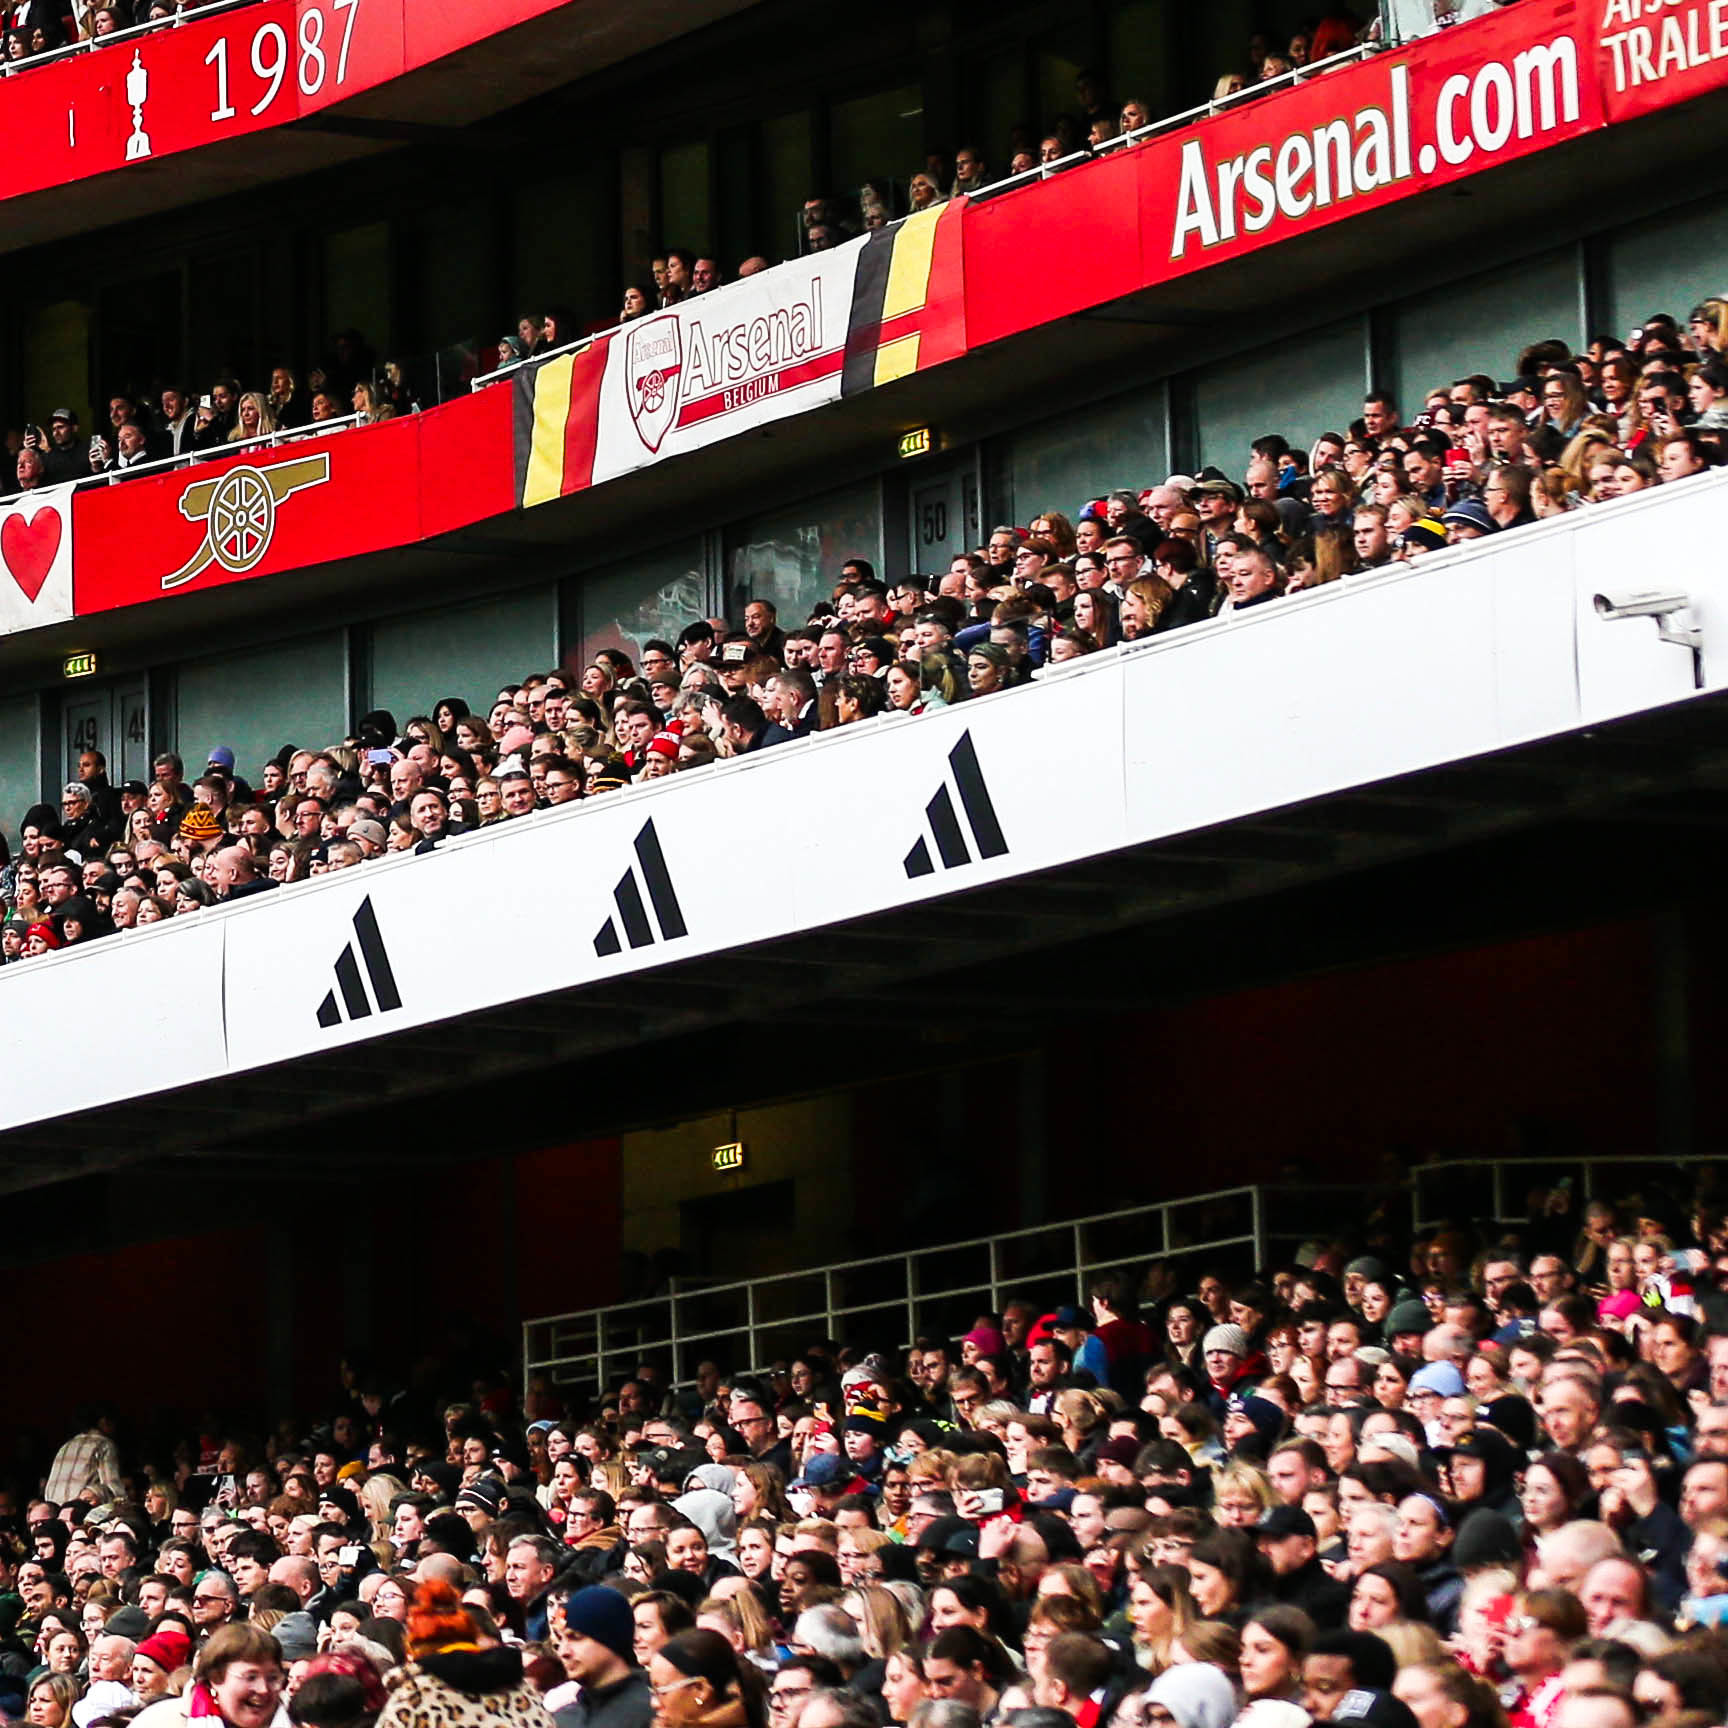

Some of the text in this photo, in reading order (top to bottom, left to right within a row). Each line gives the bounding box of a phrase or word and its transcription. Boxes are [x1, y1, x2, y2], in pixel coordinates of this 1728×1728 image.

[1170, 35, 1580, 262] Arsenal.com
[682, 276, 823, 397] Arsenal
[723, 373, 779, 410] BELGIUM
[924, 501, 946, 544] 50
[73, 717, 98, 751] 49
